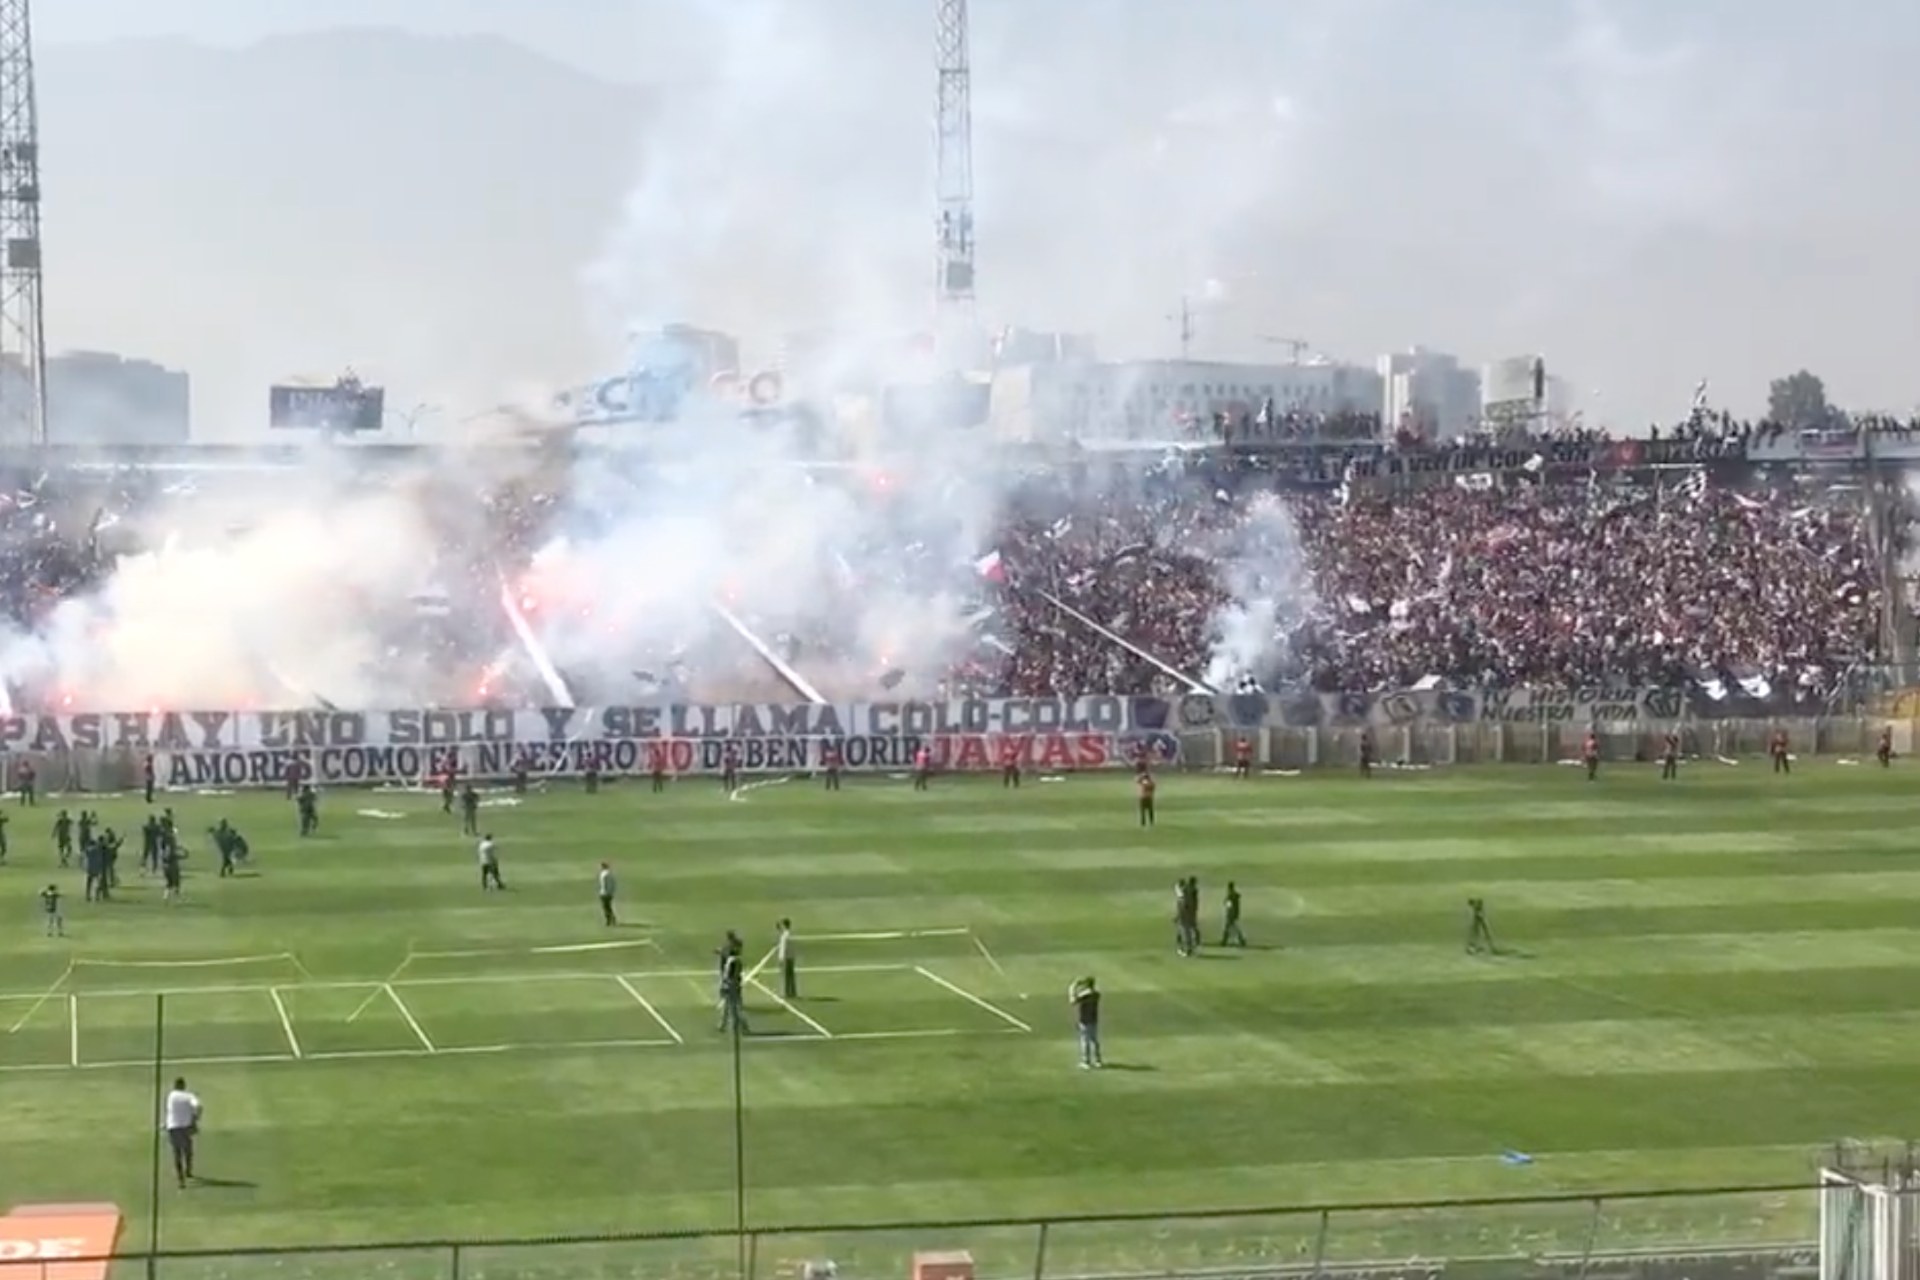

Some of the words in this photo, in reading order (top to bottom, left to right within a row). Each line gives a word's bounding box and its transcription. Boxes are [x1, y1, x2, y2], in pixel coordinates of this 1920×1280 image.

[115, 712, 229, 748] HAY
[259, 712, 364, 747] UNO
[389, 709, 514, 743] SOLO
[541, 708, 575, 739] Y
[603, 706, 661, 738] SE
[670, 704, 845, 737] LLAMA
[869, 699, 1121, 735] COLO-COLO
[1592, 704, 1637, 720] VIDA
[169, 751, 312, 784] AMORES
[322, 748, 419, 779] COMO
[644, 740, 693, 769] NO
[703, 738, 807, 768] DEBEN
